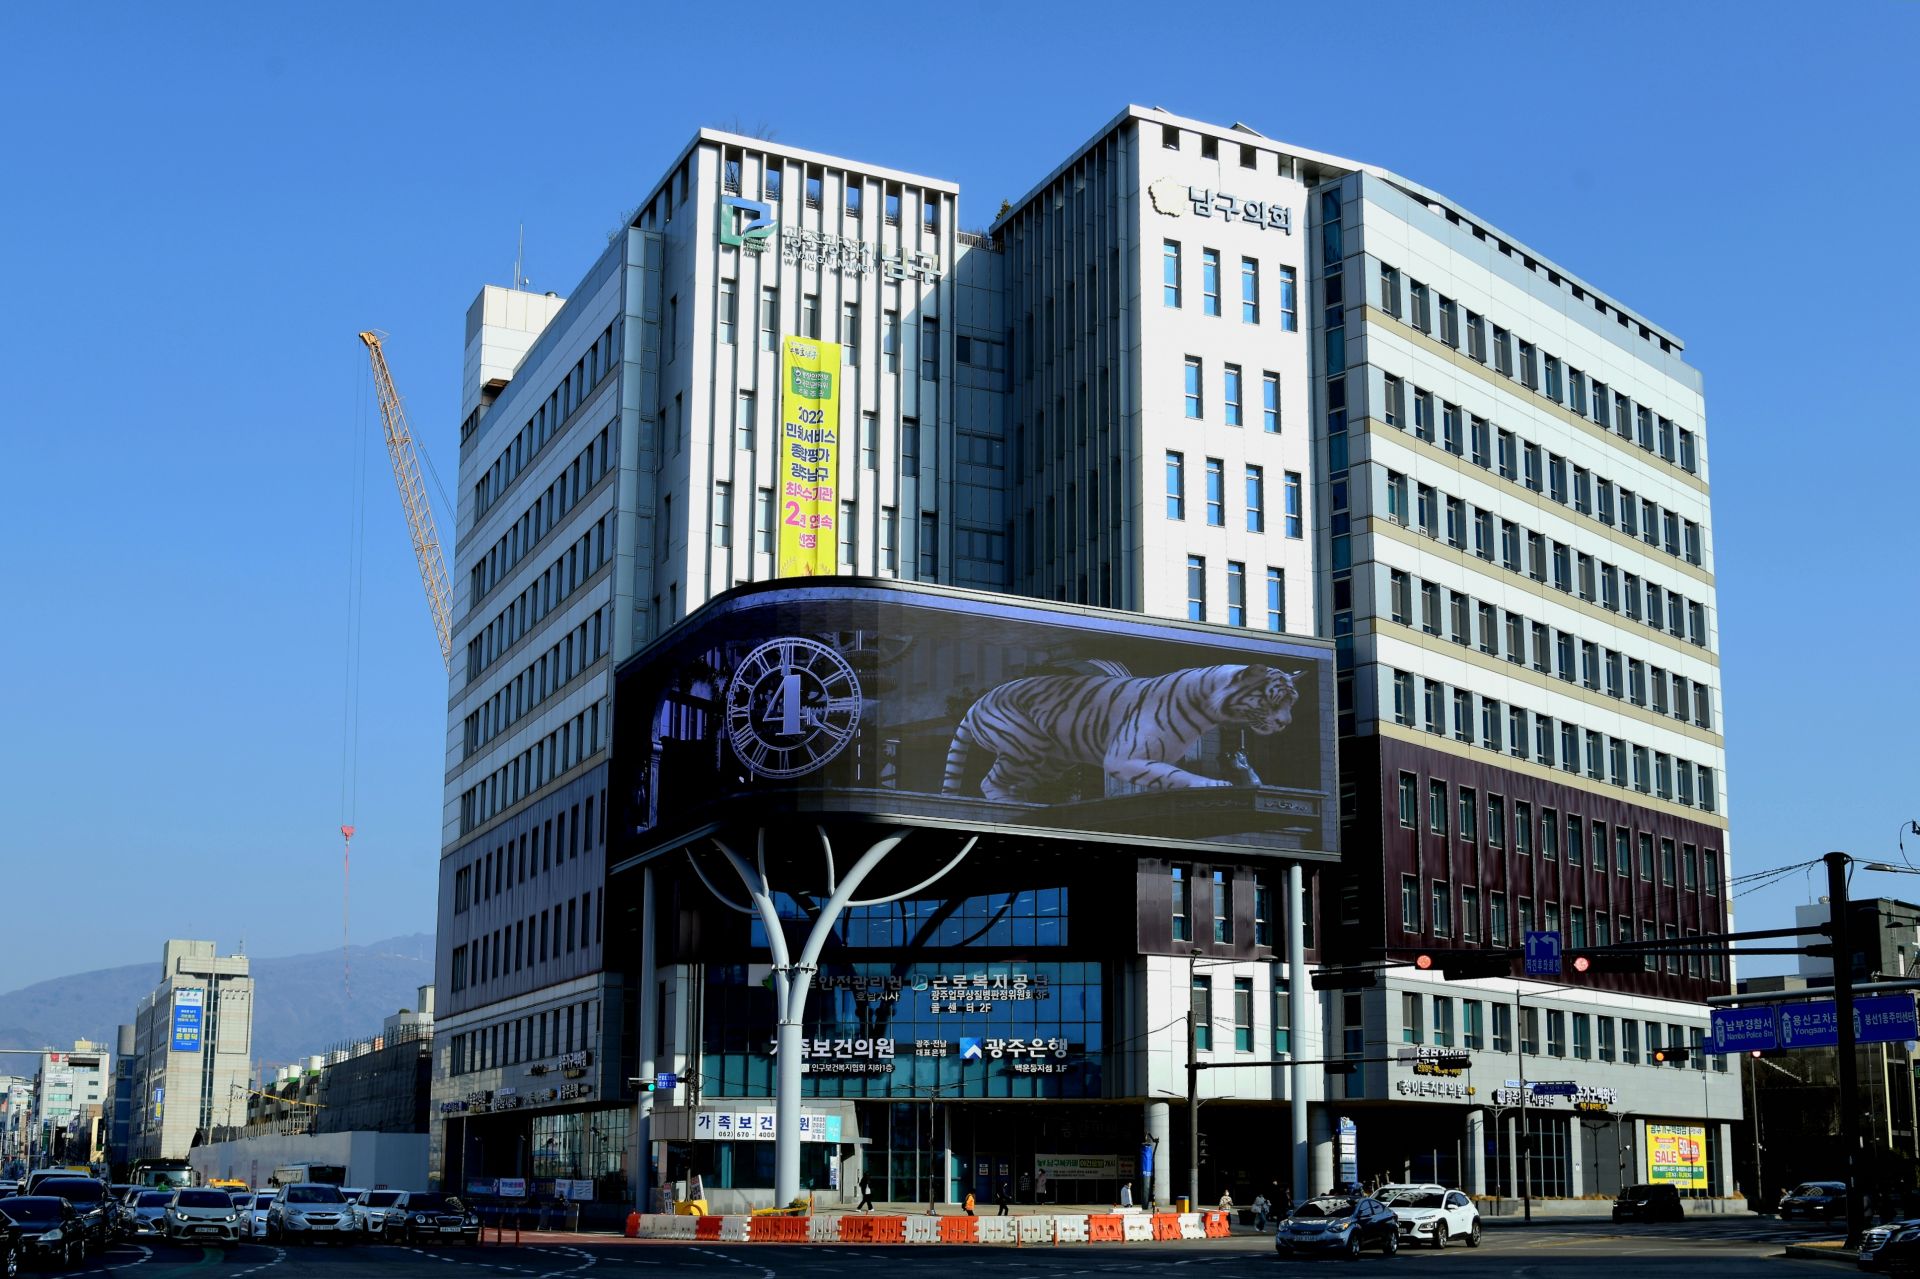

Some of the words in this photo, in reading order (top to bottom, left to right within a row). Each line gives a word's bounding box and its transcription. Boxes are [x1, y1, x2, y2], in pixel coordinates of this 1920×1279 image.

[1190, 186, 1292, 235] 남구의회
[882, 242, 943, 285] 남구
[798, 406, 824, 424] 2022
[786, 422, 836, 444] 민원서비스
[791, 443, 830, 463] 종합평가
[791, 462, 829, 482] 광주남구
[786, 481, 833, 502] 최우수기관
[932, 973, 1048, 990] 근로복지공단
[931, 989, 1033, 1000] 광주업무상질병판정위원회
[979, 1003, 992, 1013] 2F
[1726, 1017, 1772, 1032] 남부경찰서
[1794, 1025, 1826, 1035] Yongsan
[915, 1048, 947, 1057] 대표은행
[985, 1038, 1068, 1058] 광주은행
[812, 1063, 866, 1073] 인구보건복지협회
[1014, 1064, 1053, 1073] 백운동지점
[1056, 1064, 1068, 1072] 1F
[1655, 1150, 1677, 1163] SALE
